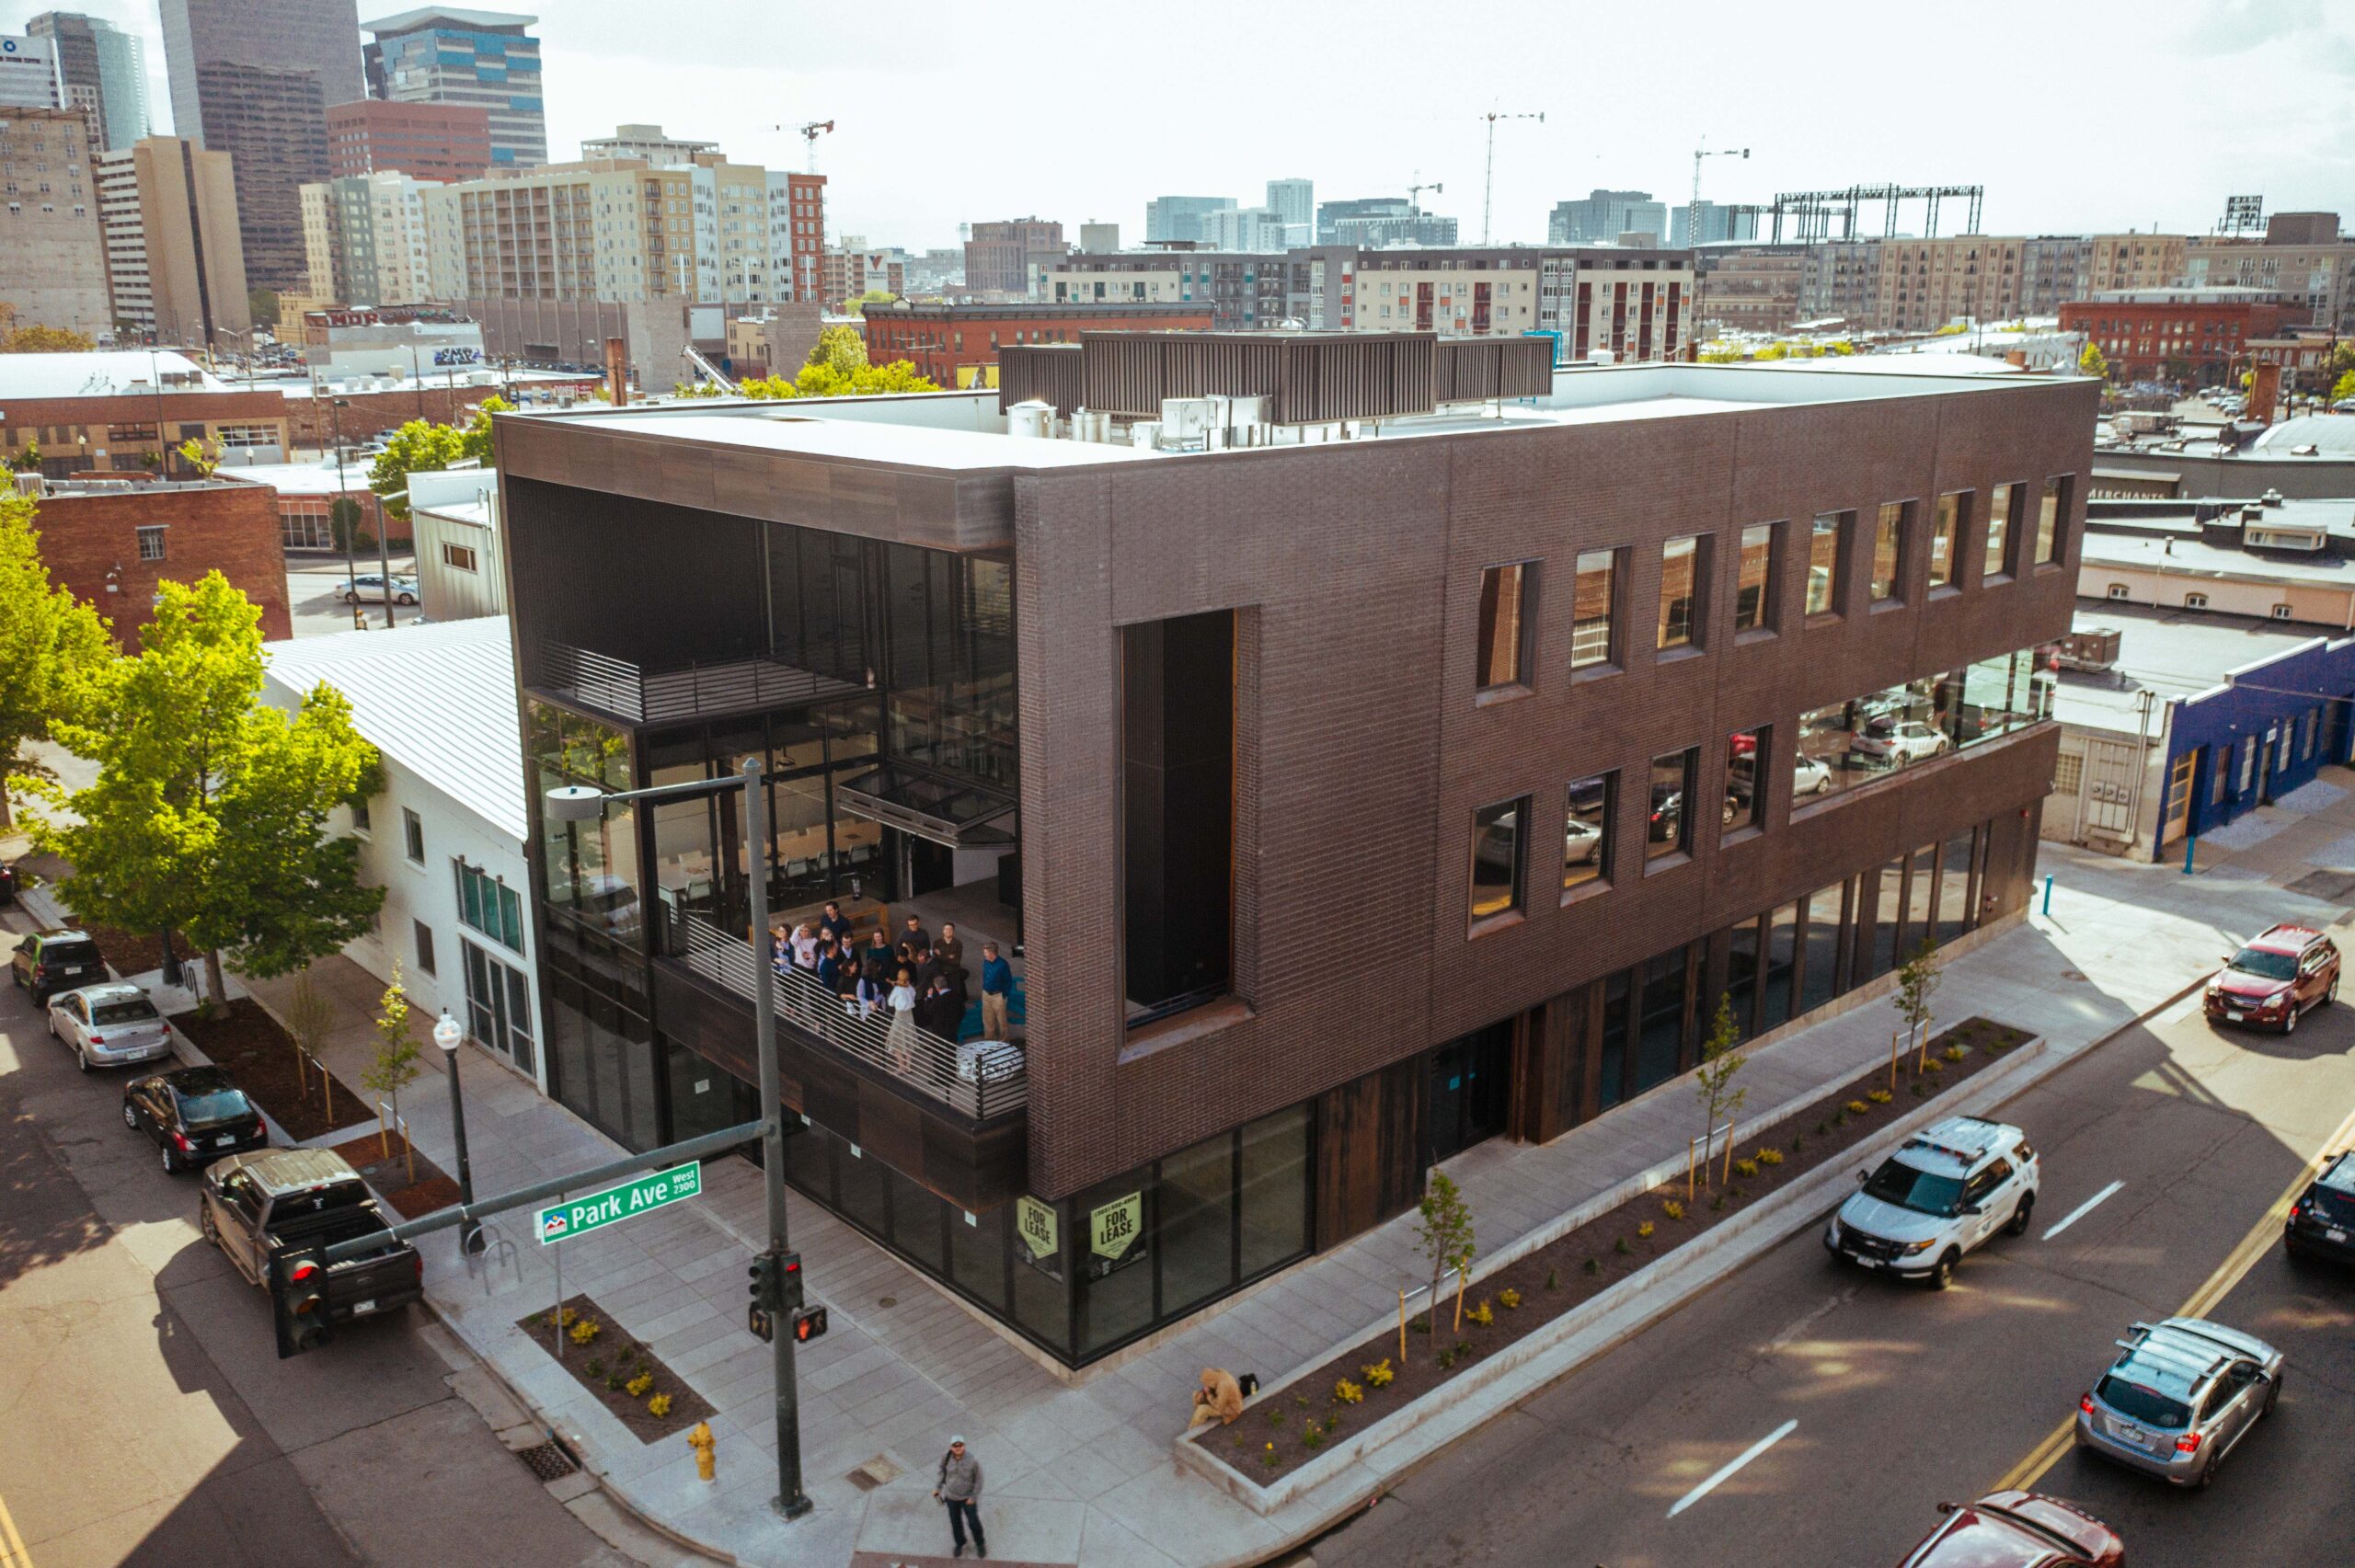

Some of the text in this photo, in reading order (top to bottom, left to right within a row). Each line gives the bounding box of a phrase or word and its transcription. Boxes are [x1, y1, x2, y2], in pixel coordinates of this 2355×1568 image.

[2087, 488, 2165, 500] MERCHANTS
[672, 1170, 695, 1185] West
[672, 1180, 696, 1195] 2300
[571, 1183, 668, 1229] Park Ave
[1028, 1207, 1046, 1229] FOR
[1105, 1207, 1128, 1230] FOR
[1025, 1218, 1051, 1245] LEASE
[1100, 1219, 1133, 1246] LEASE
